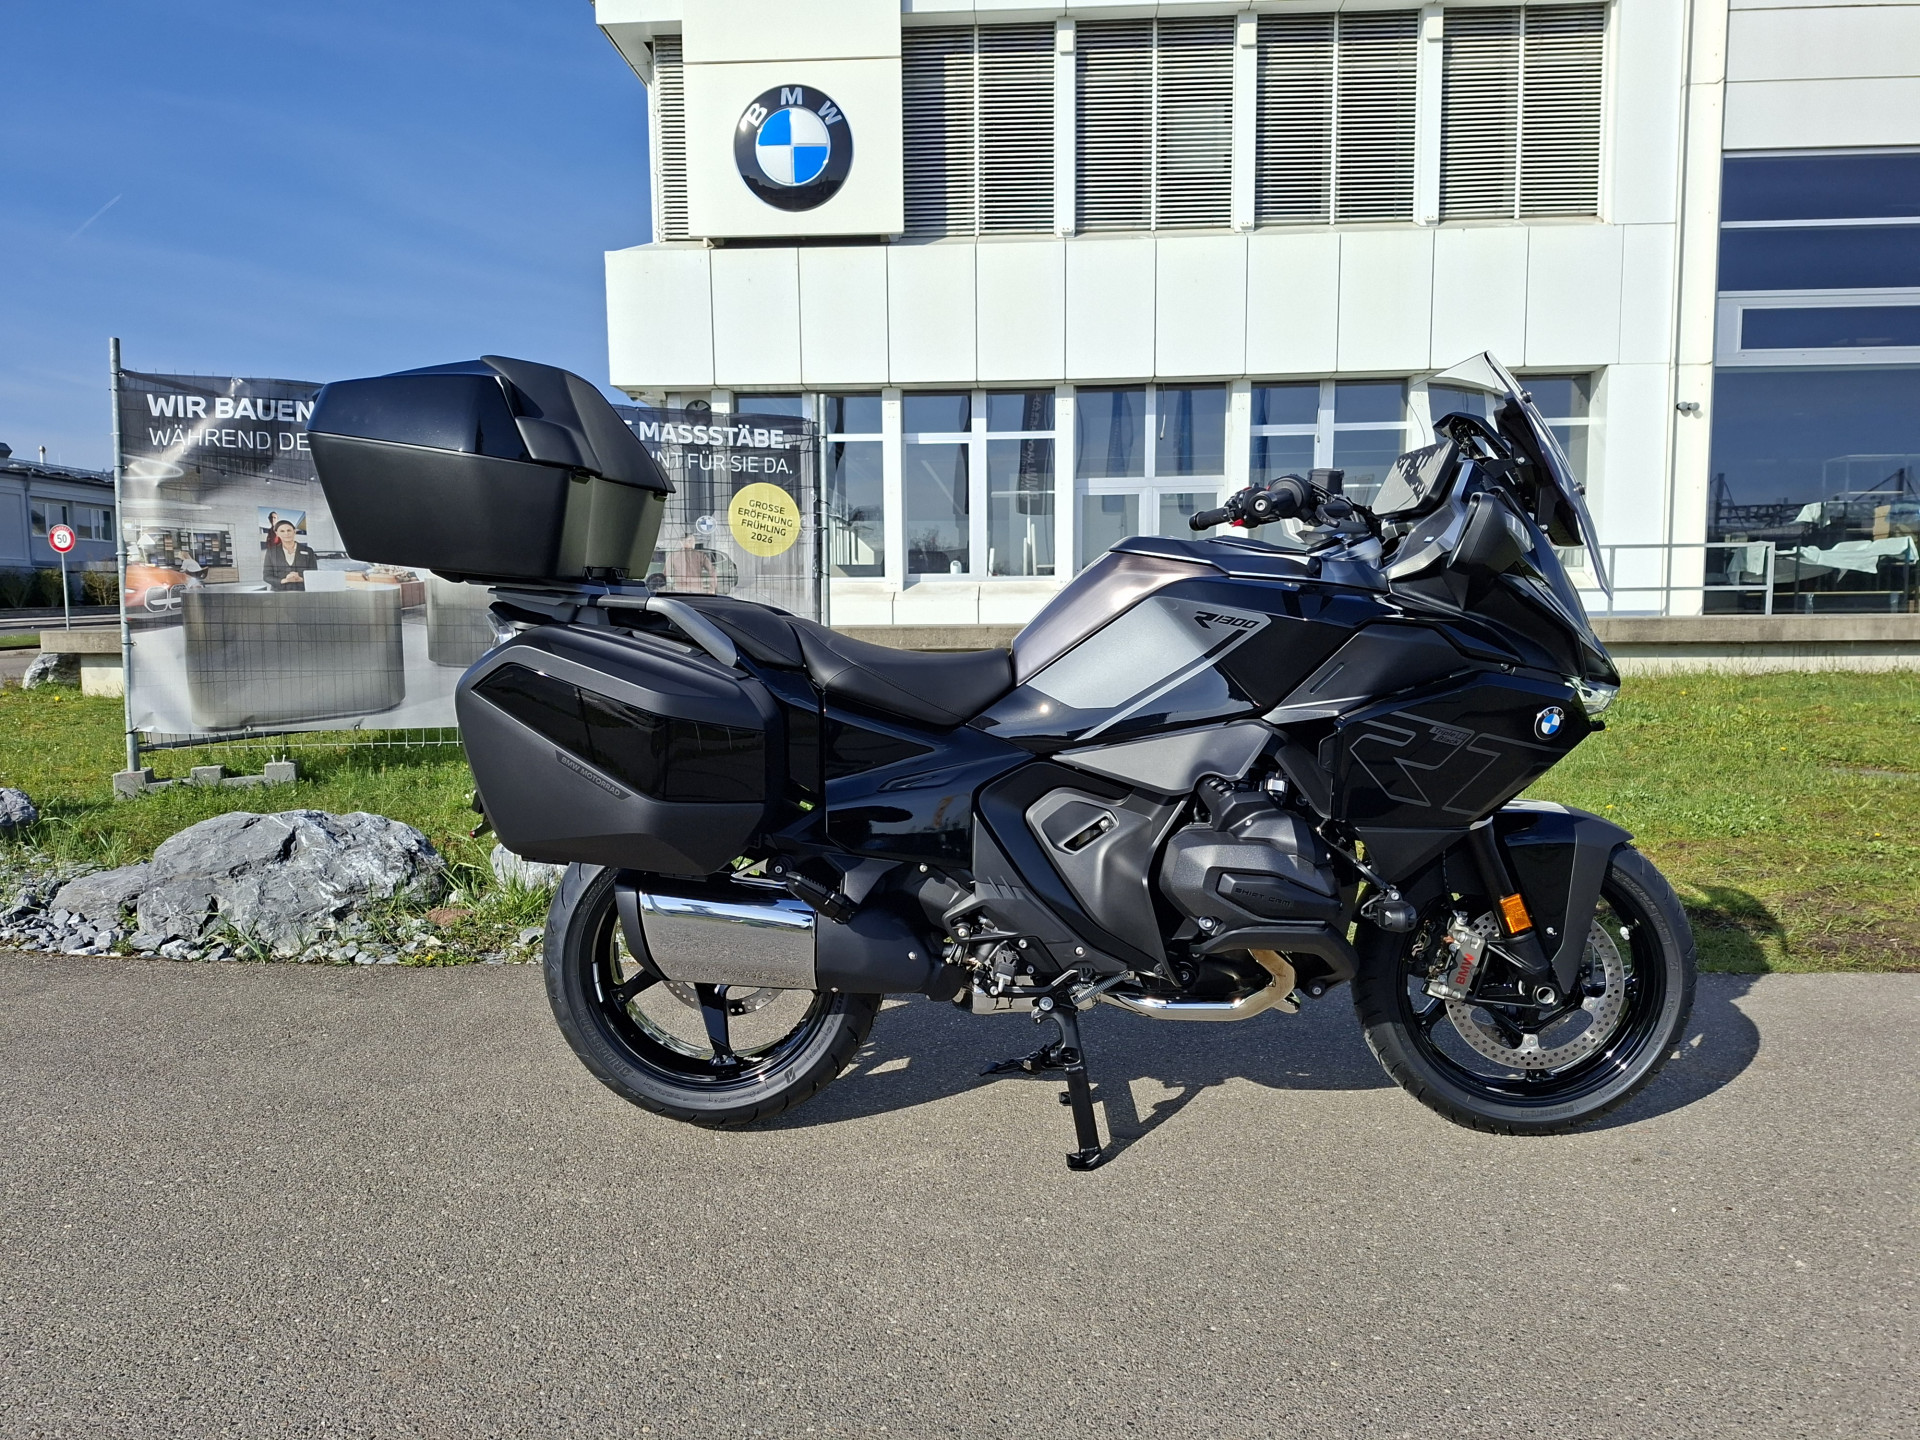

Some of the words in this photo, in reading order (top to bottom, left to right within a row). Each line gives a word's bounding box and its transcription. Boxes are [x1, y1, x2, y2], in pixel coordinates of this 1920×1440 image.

[739, 86, 842, 132] BMW
[146, 393, 207, 418] WIR
[214, 397, 315, 422] BAUEN
[149, 424, 271, 450] WÄHREND
[279, 432, 311, 451] DE
[639, 421, 791, 449] MASSSTÄBE.
[687, 450, 725, 471] FÜR
[730, 455, 759, 473] SIE
[764, 457, 793, 474] DA.
[737, 507, 793, 528] ERÖFFNUNG
[749, 499, 786, 515] GROSSE
[56, 533, 68, 544] 50
[741, 518, 787, 537] FRÜHLING
[750, 531, 773, 544] 2026
[1543, 707, 1565, 721] BMW
[561, 756, 580, 771] BMW
[580, 768, 621, 796] MOTORRAD
[1455, 953, 1475, 985] BMW
